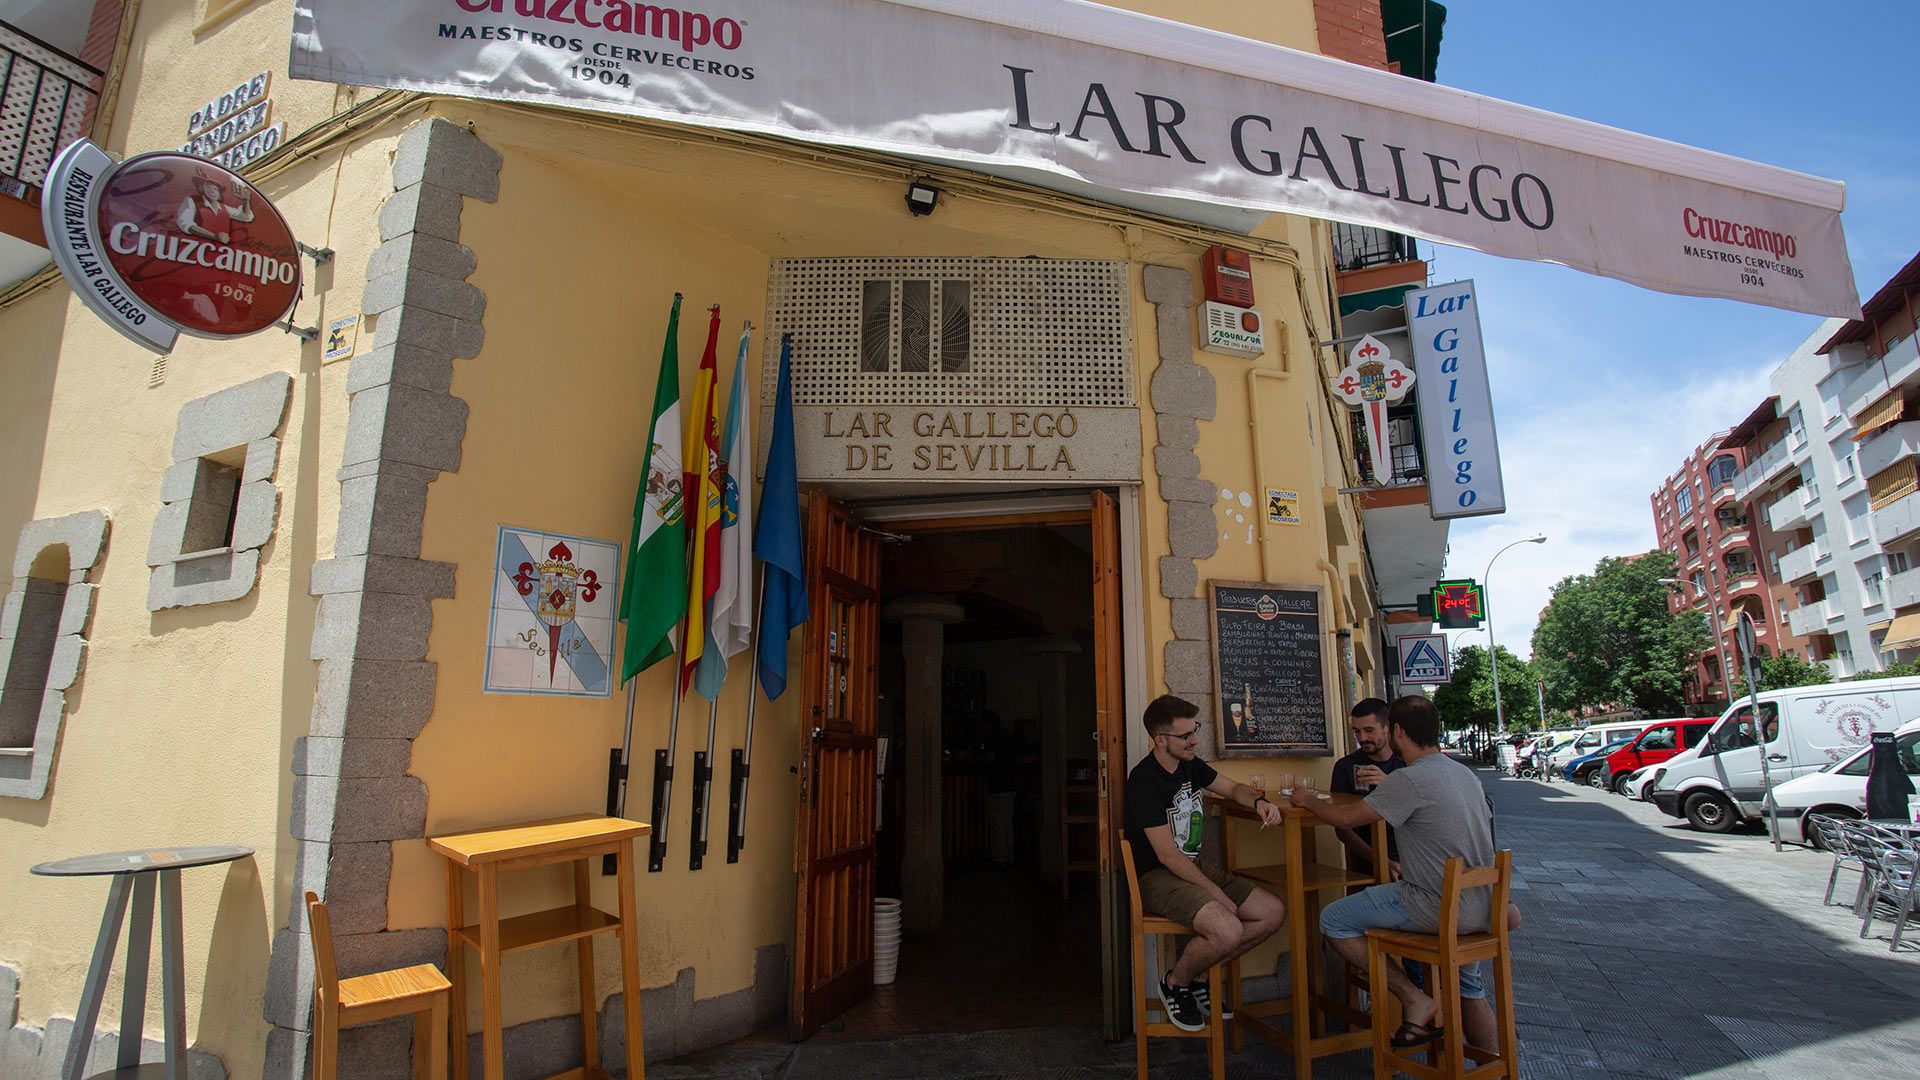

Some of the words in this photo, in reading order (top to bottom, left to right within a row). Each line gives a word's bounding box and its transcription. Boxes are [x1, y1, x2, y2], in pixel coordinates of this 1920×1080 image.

[437, 23, 584, 52] MAESTROS
[592, 42, 755, 81] CERVECEROS
[583, 56, 623, 71] DESDE
[570, 65, 632, 89] 1904
[187, 72, 267, 136] PADRE
[176, 101, 268, 157] ENDEZ
[1002, 63, 1206, 165] LAR
[1229, 113, 1555, 231] GALLEGO
[64, 166, 94, 251] RESTAURANTE
[1683, 207, 1797, 261] Cruzcampo
[76, 252, 103, 278] LAR
[109, 221, 296, 286] Cruzcampo
[1683, 245, 1742, 264] MAESTROS
[1744, 256, 1804, 279] CERVECEROS
[213, 282, 254, 305] 1904
[1740, 273, 1765, 287] 1904
[93, 277, 146, 326] GALLEGO
[1414, 292, 1471, 319] Lar
[823, 411, 893, 438] LAR
[913, 411, 1078, 438] GALLEGO
[1432, 326, 1477, 508] Gallego
[845, 444, 893, 471] DE
[912, 444, 1077, 471] SEVILLA
[1279, 620, 1305, 631] BRASA
[1409, 669, 1440, 677] ALDI
